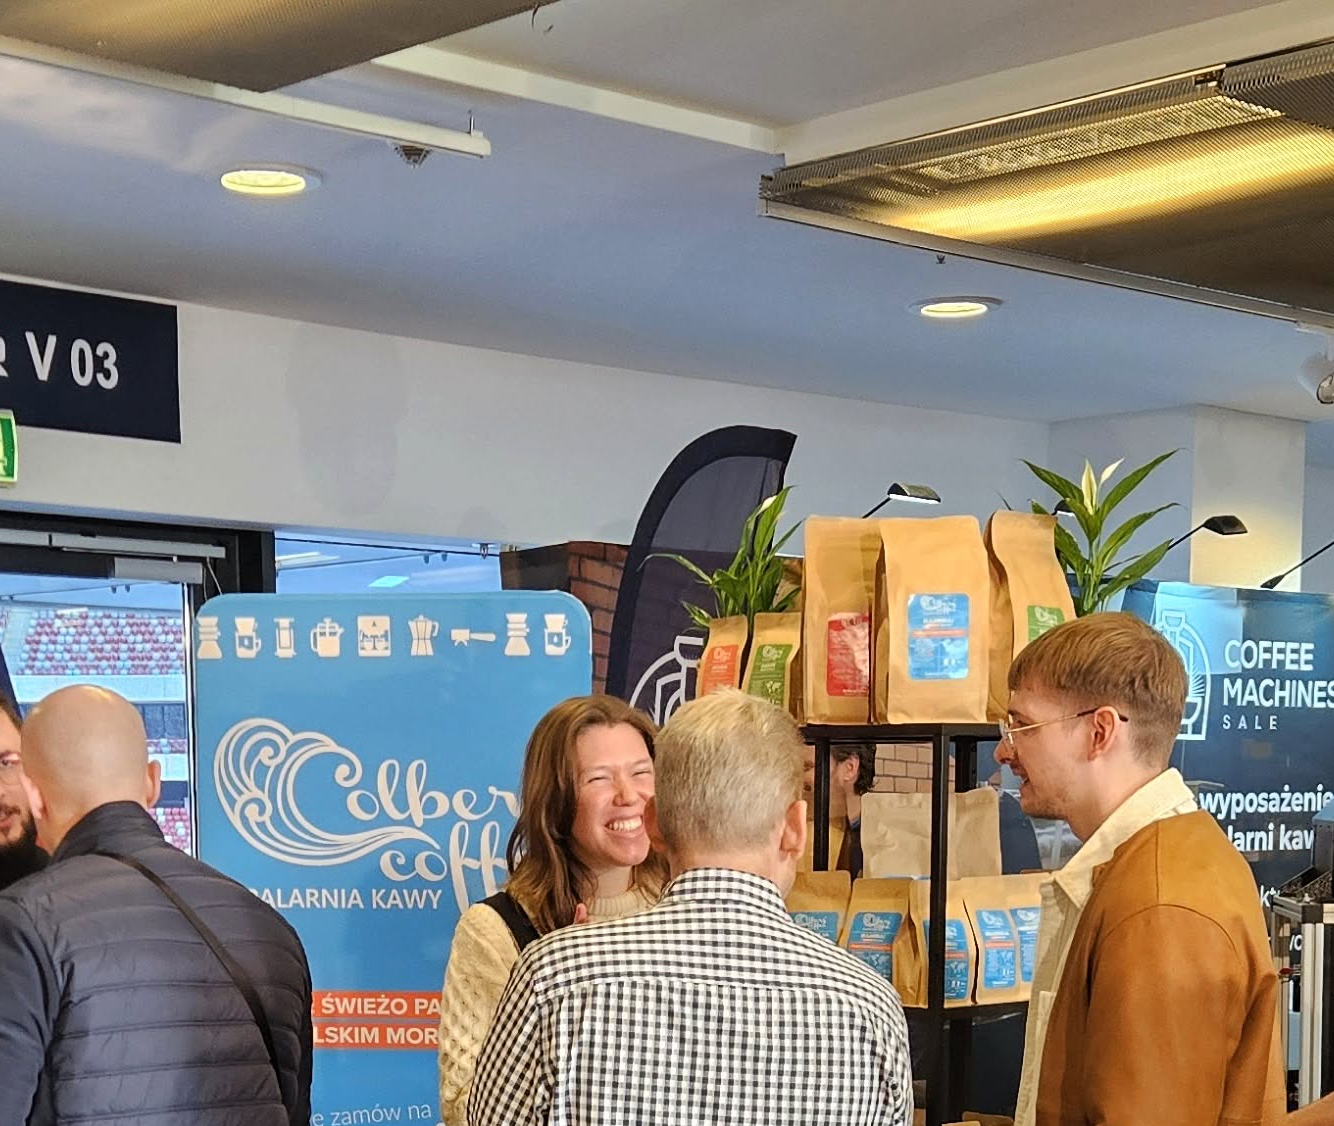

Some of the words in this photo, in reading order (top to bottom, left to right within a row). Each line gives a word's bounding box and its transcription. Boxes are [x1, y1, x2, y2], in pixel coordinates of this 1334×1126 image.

[24, 330, 57, 383] V
[69, 337, 120, 390] 03
[1224, 639, 1315, 672] COFFEE
[1222, 714, 1278, 730] SALE
[371, 888, 443, 910] KAWY
[321, 992, 408, 1016] ŚWIEŻO
[407, 1103, 433, 1121] na
